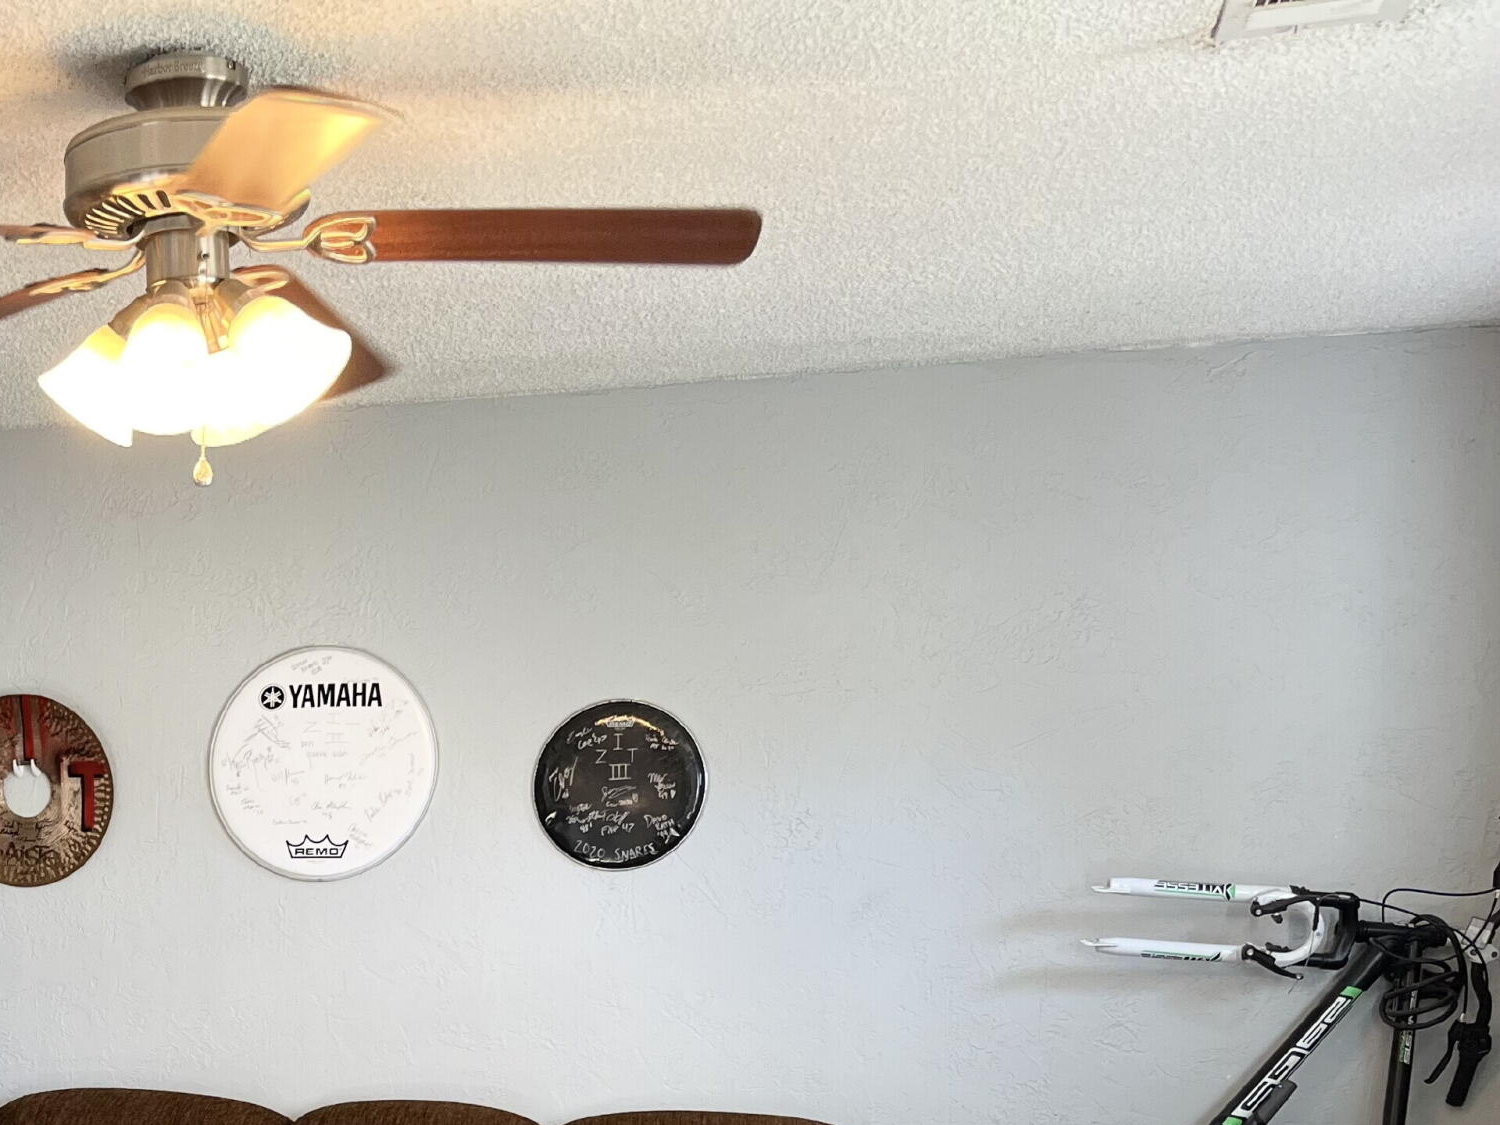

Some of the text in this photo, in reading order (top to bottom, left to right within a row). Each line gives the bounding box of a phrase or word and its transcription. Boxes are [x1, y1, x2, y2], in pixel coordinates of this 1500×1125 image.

[289, 683, 382, 709] YAMAHA
[294, 847, 339, 856] REMO
[573, 840, 606, 859] 2020
